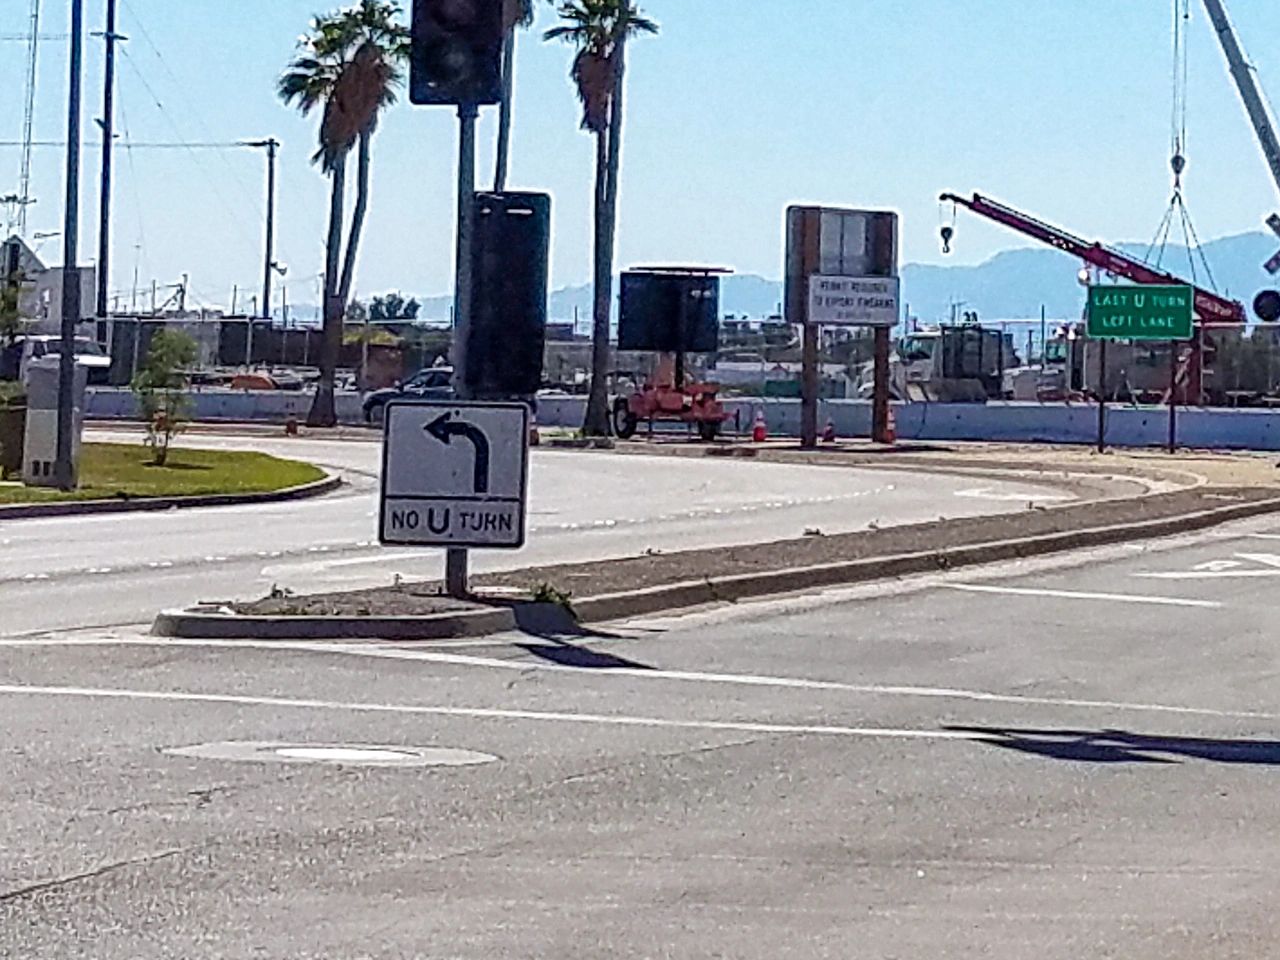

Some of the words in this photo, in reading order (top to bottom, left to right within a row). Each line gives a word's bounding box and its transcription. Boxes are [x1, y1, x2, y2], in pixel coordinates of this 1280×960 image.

[1094, 295, 1127, 306] LAST
[1134, 293, 1145, 308] U
[1152, 295, 1185, 308] TURN
[1102, 315, 1133, 328] LEFT
[1140, 315, 1175, 328] LANE
[391, 510, 420, 530] NO
[427, 507, 450, 535] U
[459, 511, 512, 532] TURN
